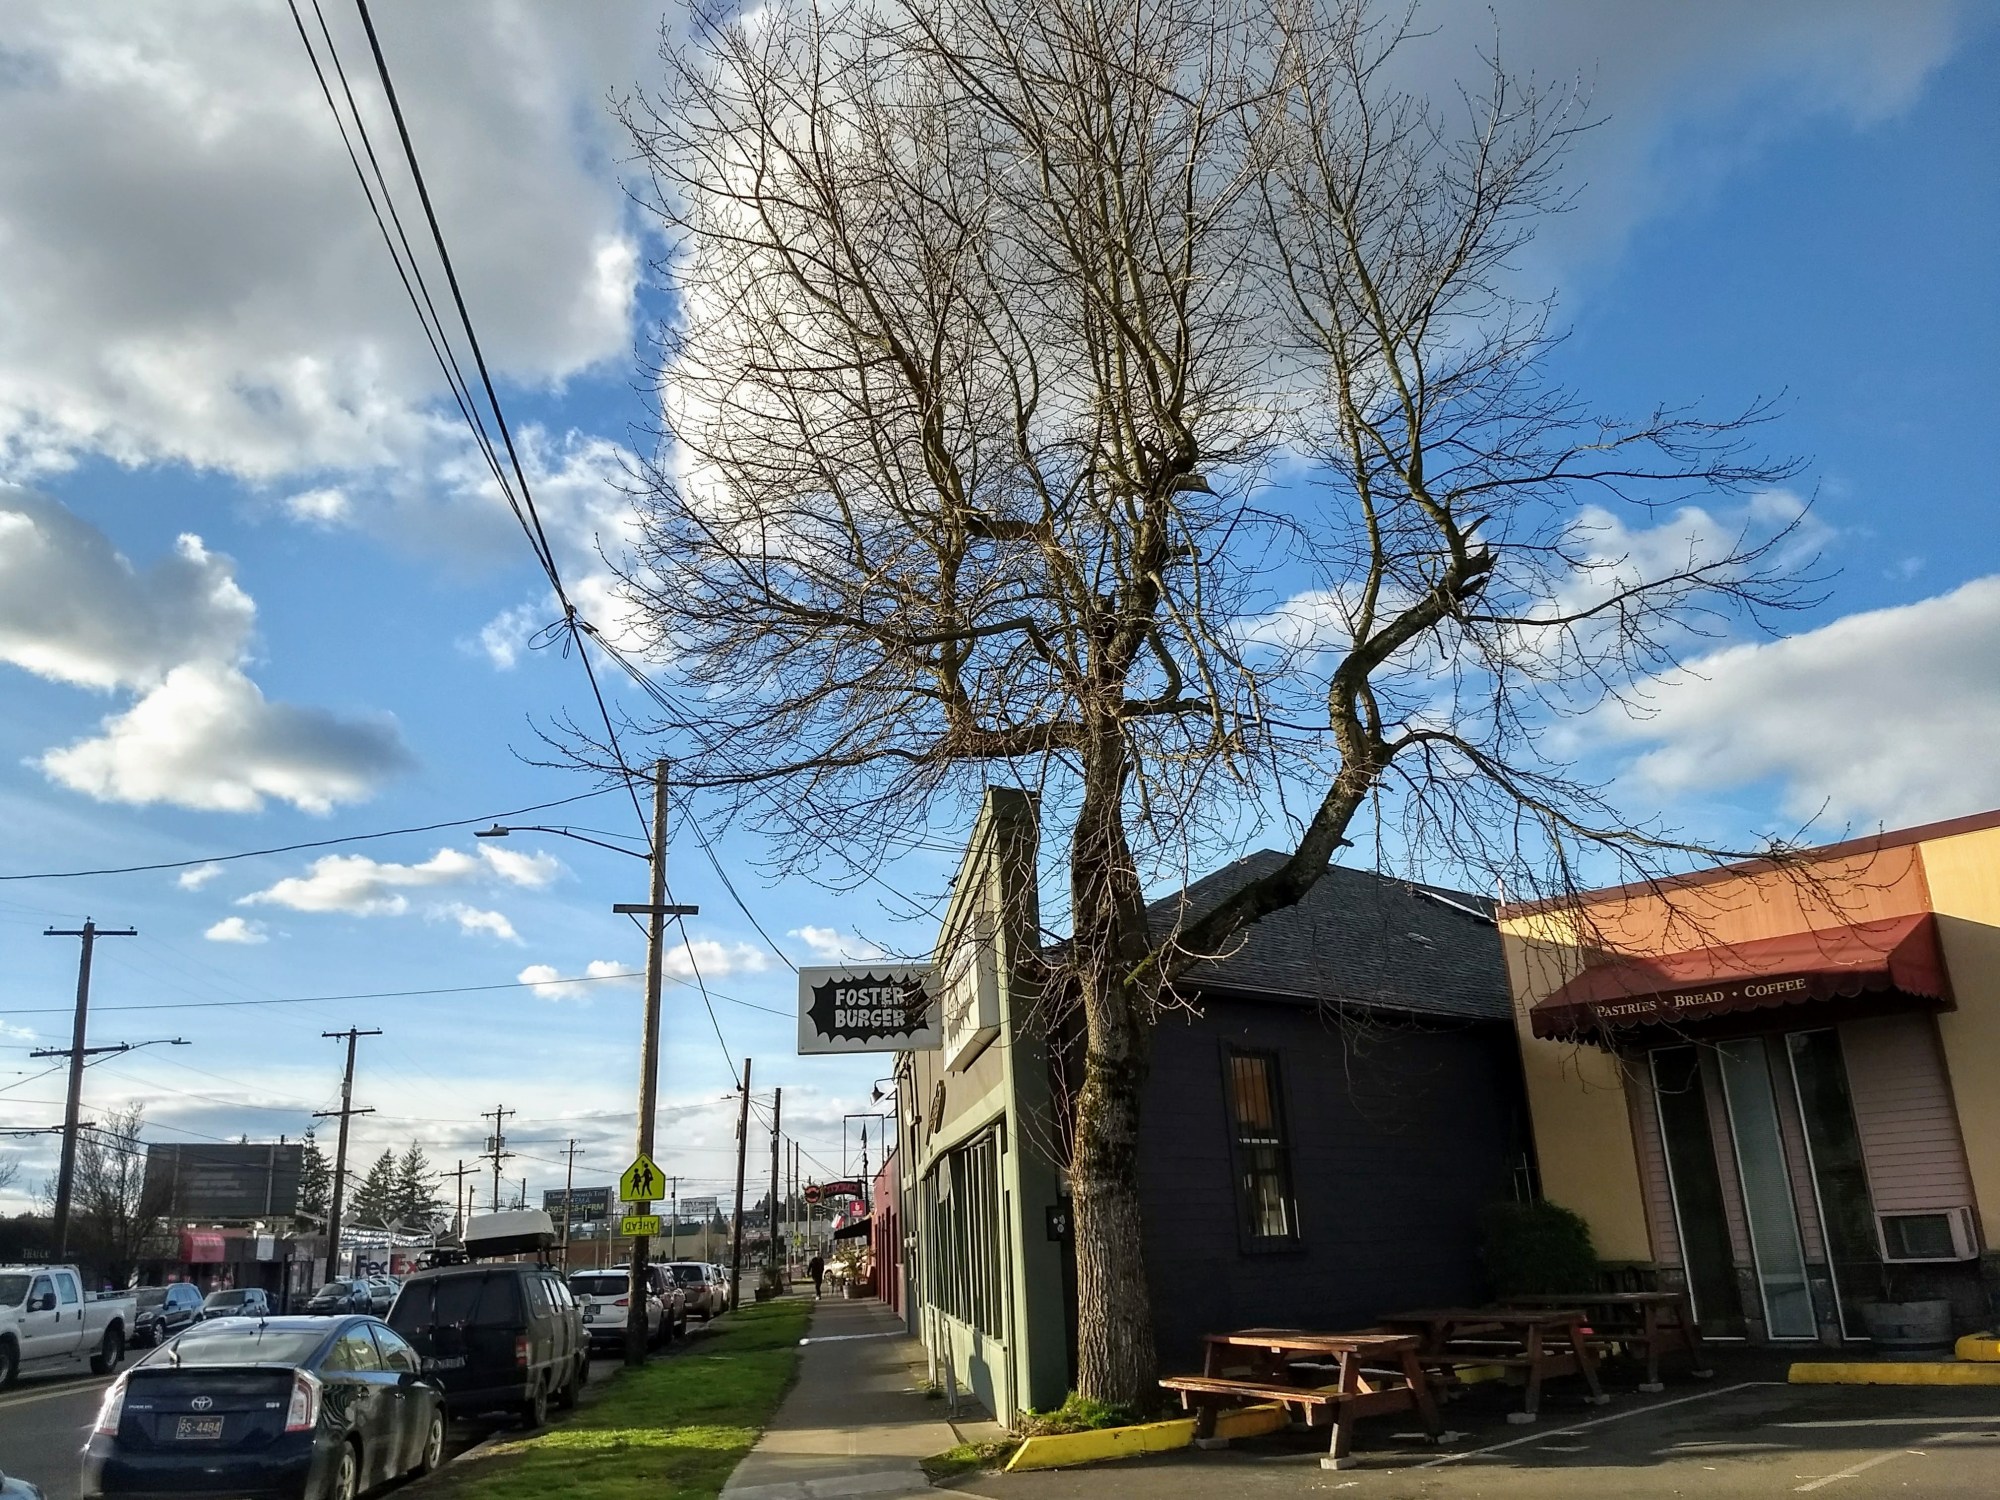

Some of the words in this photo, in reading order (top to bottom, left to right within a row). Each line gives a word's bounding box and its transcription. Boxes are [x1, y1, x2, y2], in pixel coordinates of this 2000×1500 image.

[835, 987, 906, 1006] FOSTER
[1596, 1000, 1657, 1018] PASTRIES
[1674, 990, 1725, 1008] BREAD
[1744, 978, 1807, 998] COFFEE
[835, 1009, 906, 1028] BURGER
[625, 1221, 656, 1231] AHEAD
[785, 1231, 793, 1239] 20
